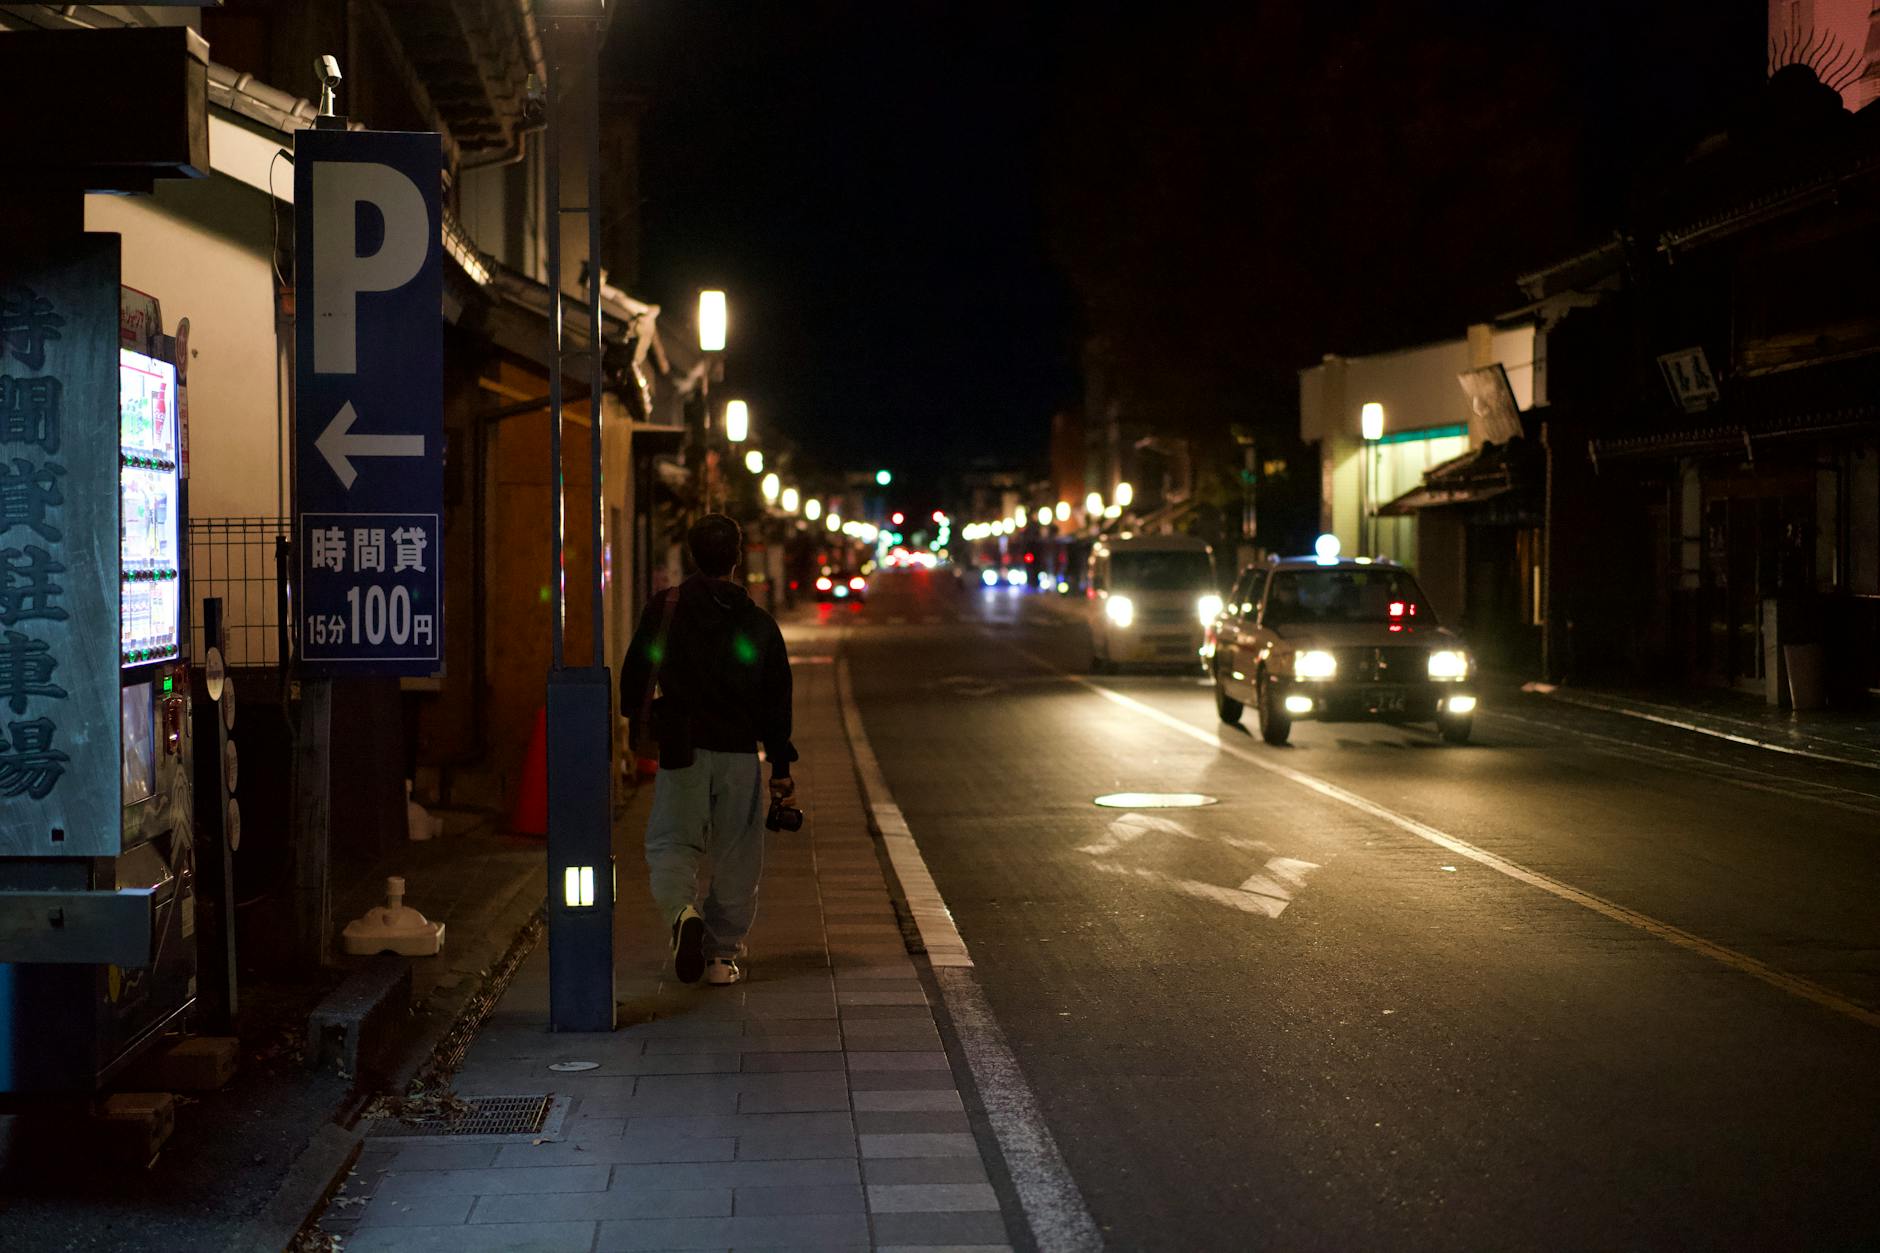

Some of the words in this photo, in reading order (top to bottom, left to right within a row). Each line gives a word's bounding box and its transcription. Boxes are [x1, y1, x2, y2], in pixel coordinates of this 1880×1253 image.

[312, 160, 430, 375] P
[311, 526, 428, 573] 時間貸
